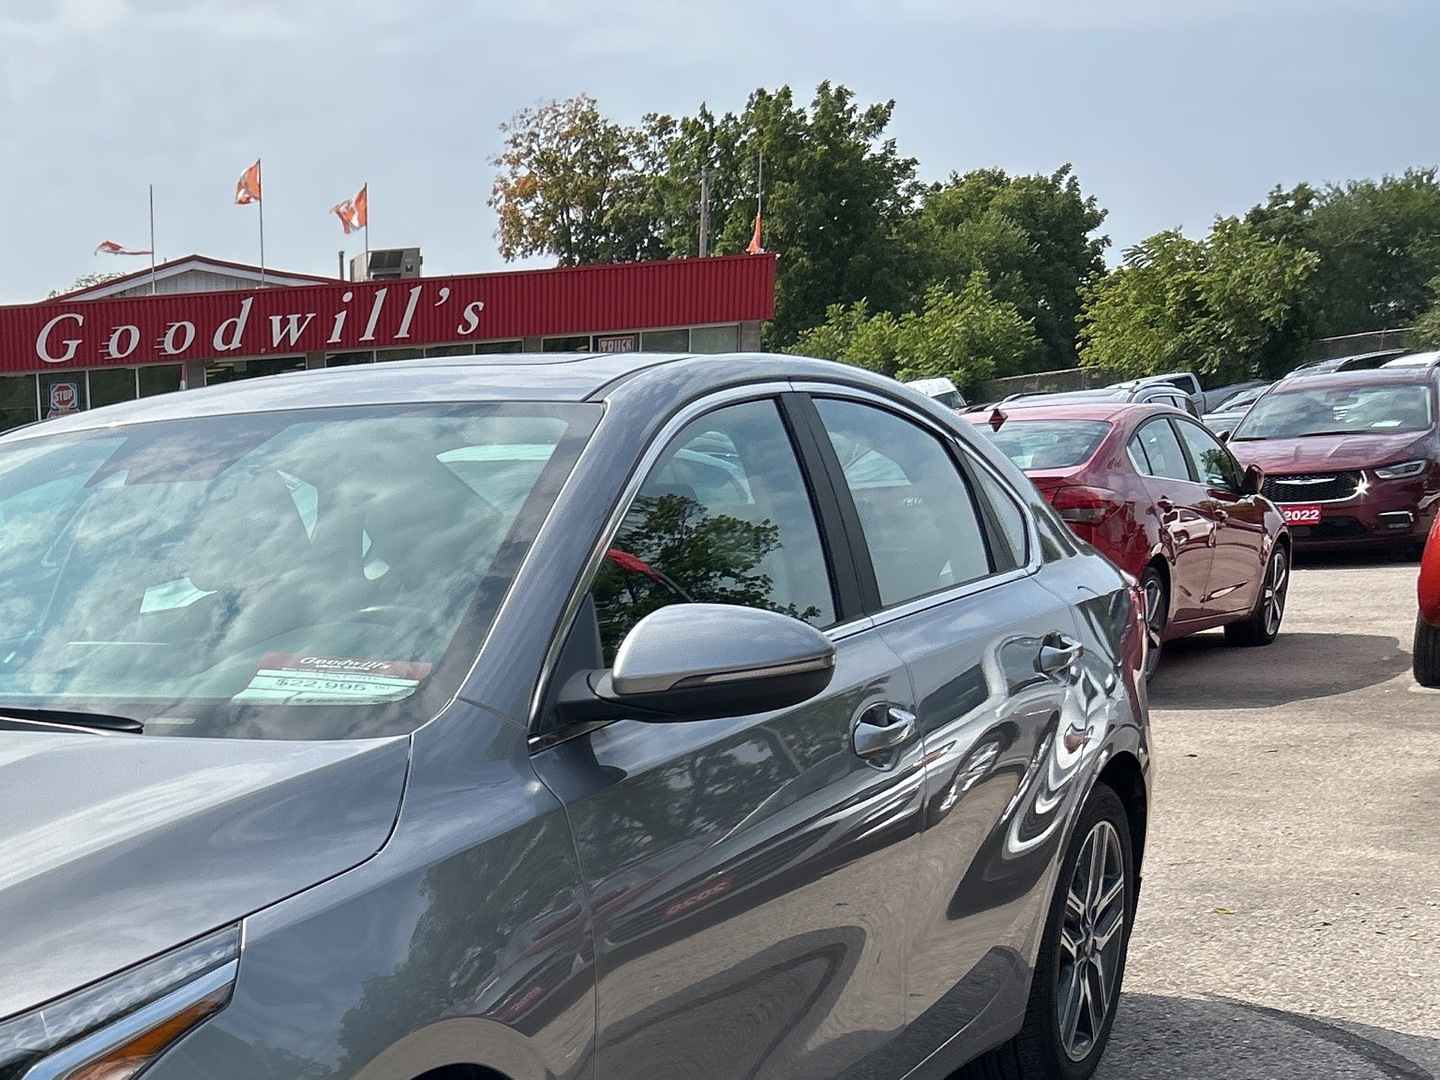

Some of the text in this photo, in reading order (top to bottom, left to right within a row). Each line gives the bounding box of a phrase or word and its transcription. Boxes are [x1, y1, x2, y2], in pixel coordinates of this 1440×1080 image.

[35, 285, 485, 364] Goodwill's
[54, 390, 73, 402] STOP
[1284, 509, 1320, 521] 2022
